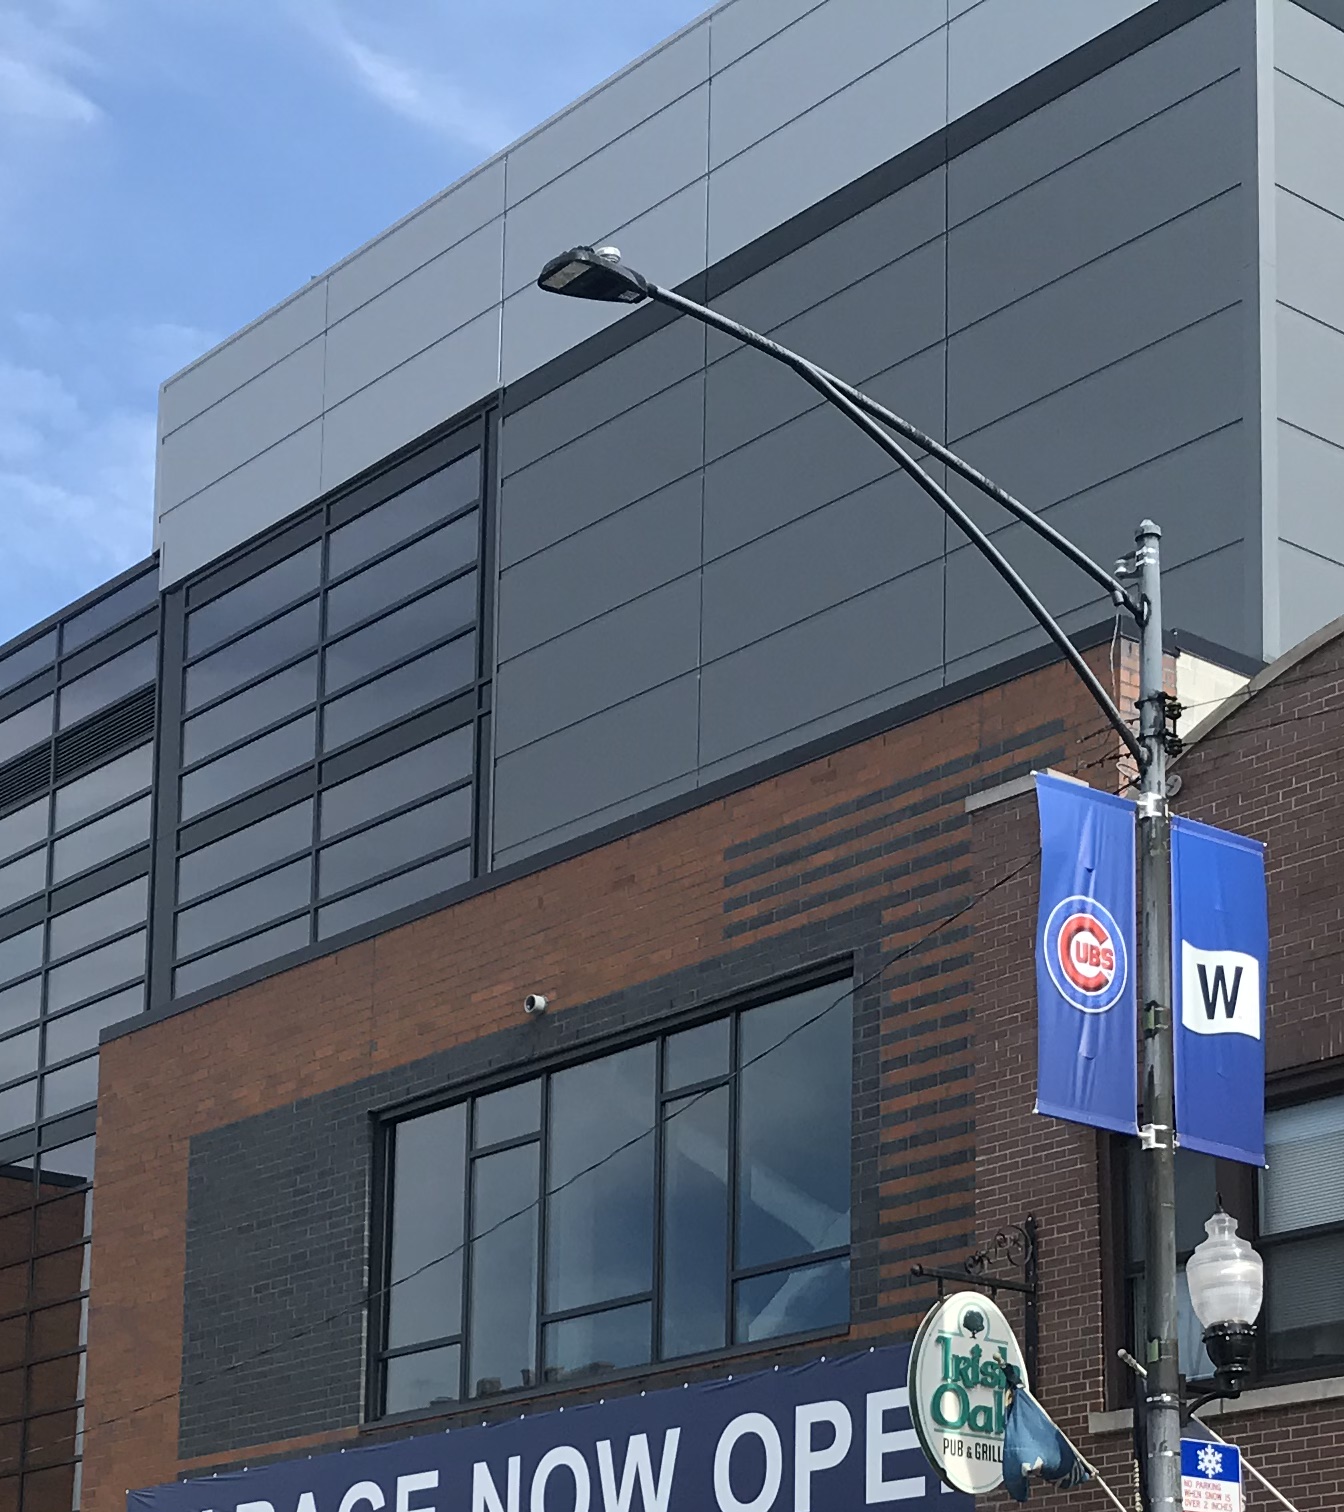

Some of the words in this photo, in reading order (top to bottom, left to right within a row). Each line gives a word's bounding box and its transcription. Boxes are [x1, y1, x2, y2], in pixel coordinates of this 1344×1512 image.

[1196, 963, 1244, 1021] W
[935, 1335, 1021, 1390] Irish
[943, 1437, 964, 1457] PUB
[966, 1446, 973, 1459] &
[974, 1442, 1004, 1463] GRILL
[1183, 1479, 1193, 1488] NO
[1195, 1481, 1222, 1491] PARKING
[1204, 1501, 1208, 1509] 2
[1225, 1493, 1231, 1502] IS
